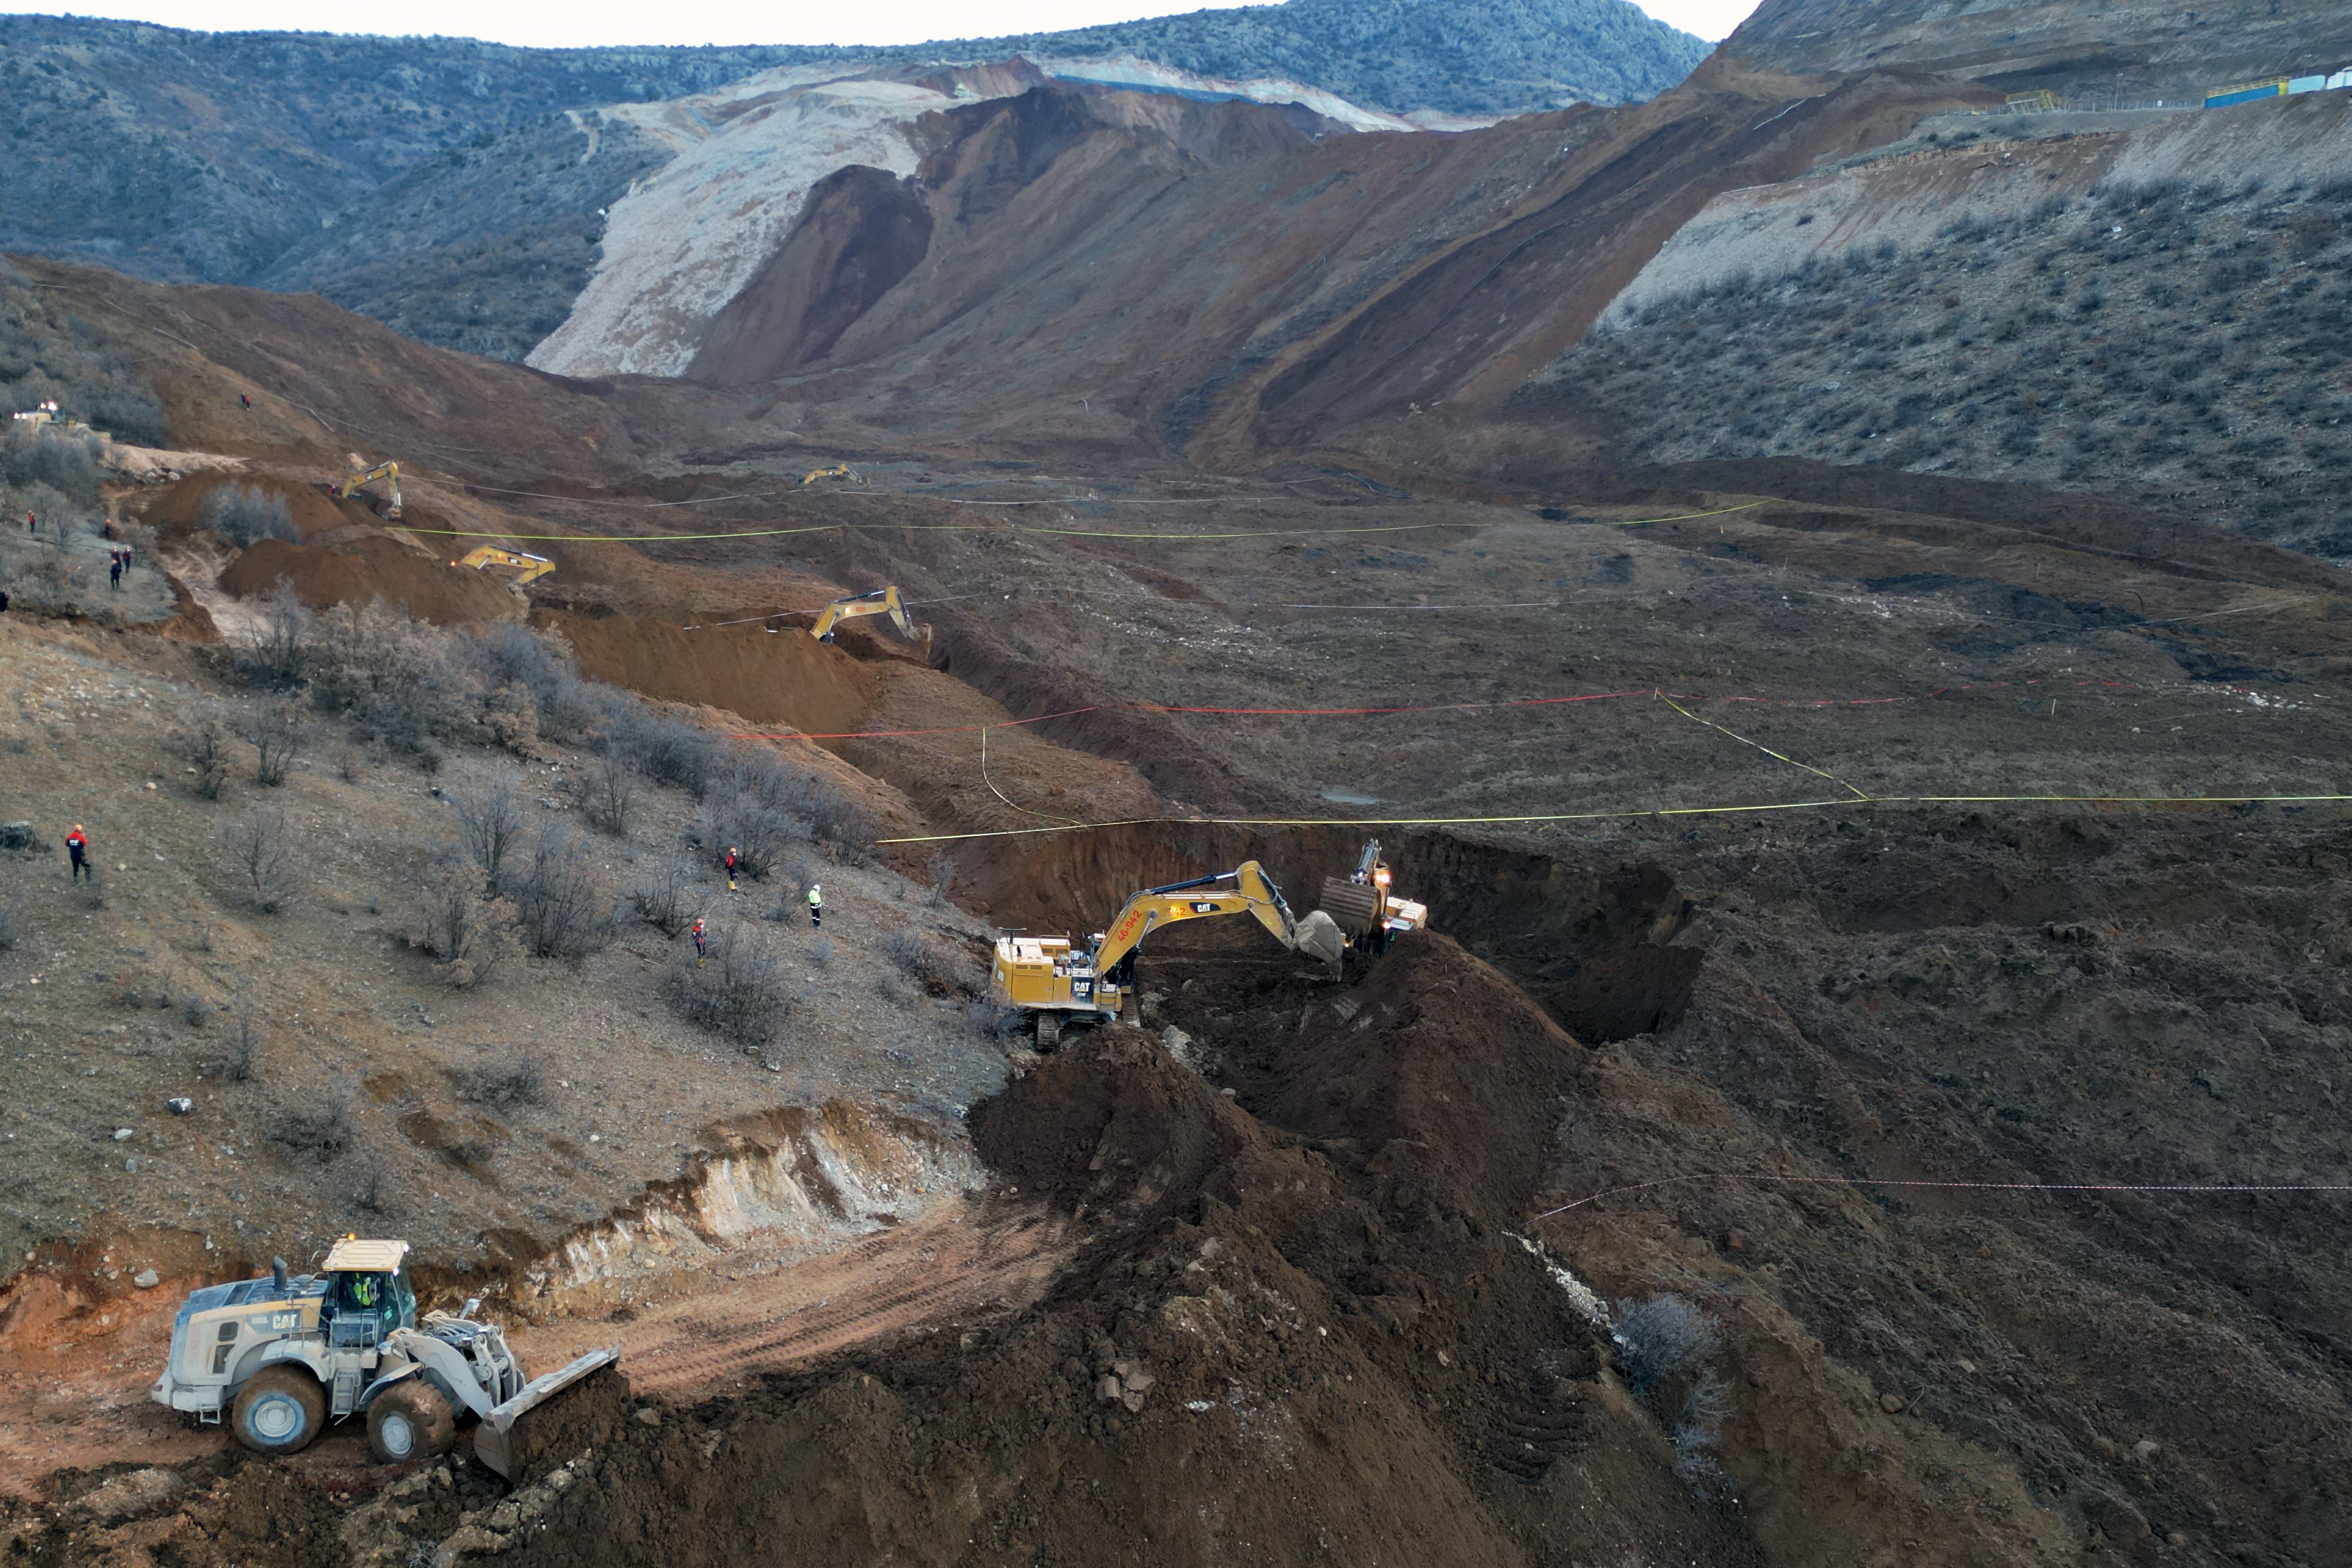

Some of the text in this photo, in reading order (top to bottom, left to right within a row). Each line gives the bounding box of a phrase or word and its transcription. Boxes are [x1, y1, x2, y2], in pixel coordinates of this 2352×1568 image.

[1197, 904, 1210, 912] CAT
[1118, 910, 1141, 941] 46-942
[1074, 982, 1090, 991] CAT
[272, 1314, 297, 1329] CAT
